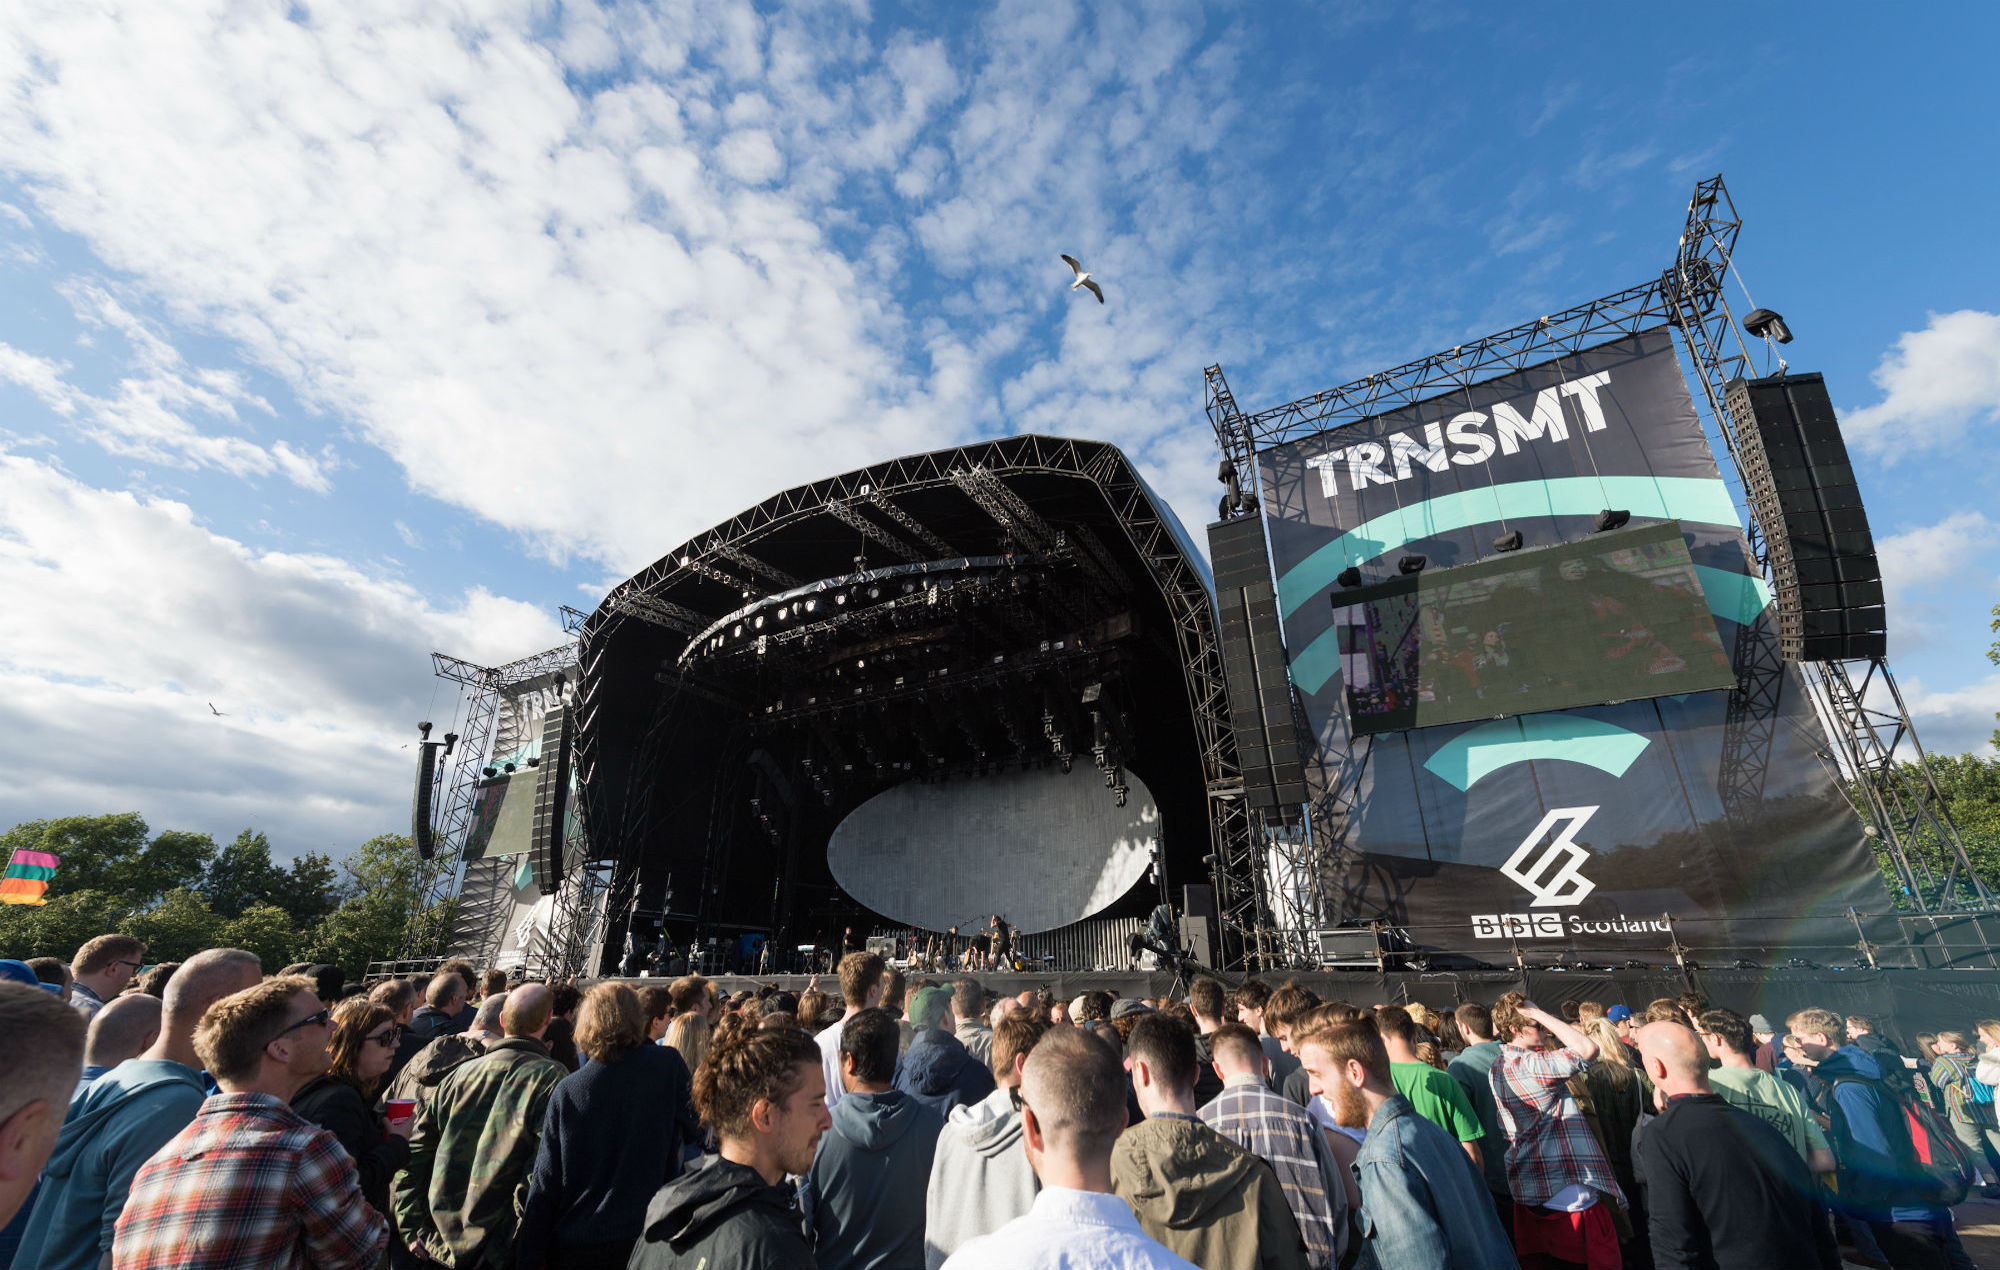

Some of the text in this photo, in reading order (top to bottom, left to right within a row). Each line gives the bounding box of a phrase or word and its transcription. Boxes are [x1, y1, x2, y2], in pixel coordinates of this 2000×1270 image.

[1306, 370, 1612, 498] TRNSMT
[518, 679, 577, 722] TRNS
[1472, 913, 1672, 938] BBC Scotland
